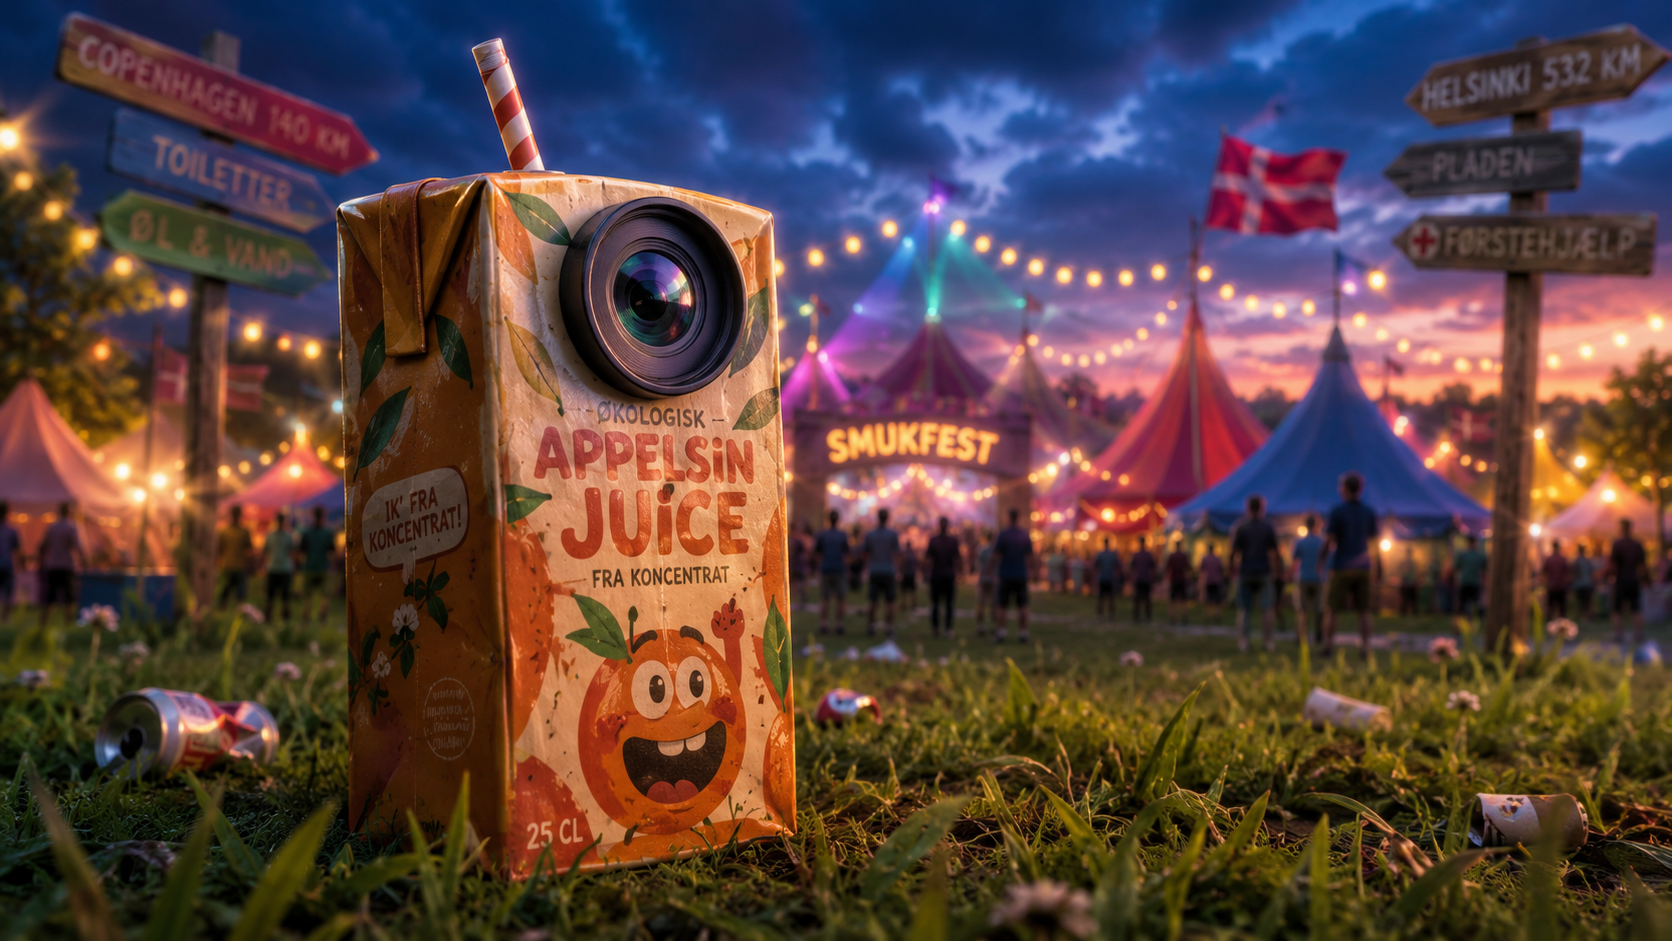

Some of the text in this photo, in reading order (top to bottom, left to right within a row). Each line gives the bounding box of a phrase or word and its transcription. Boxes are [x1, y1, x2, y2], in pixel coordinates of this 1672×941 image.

[77, 34, 350, 160] COPENHAGEN 140 KM
[1421, 43, 1643, 112] HELSINKI 532 KM
[153, 134, 292, 210] TOILETTER
[129, 210, 293, 279] ØL & VAND
[1443, 226, 1637, 260] FØRSTEHJÆLP
[596, 400, 706, 428] ØKOLOGISK
[826, 421, 1000, 465] SMUKFEST
[409, 486, 438, 515] FRA
[369, 503, 462, 554] KONCENTRAT!
[592, 565, 730, 588] FRA KONCENTRAT
[526, 817, 583, 850] 25 CL
